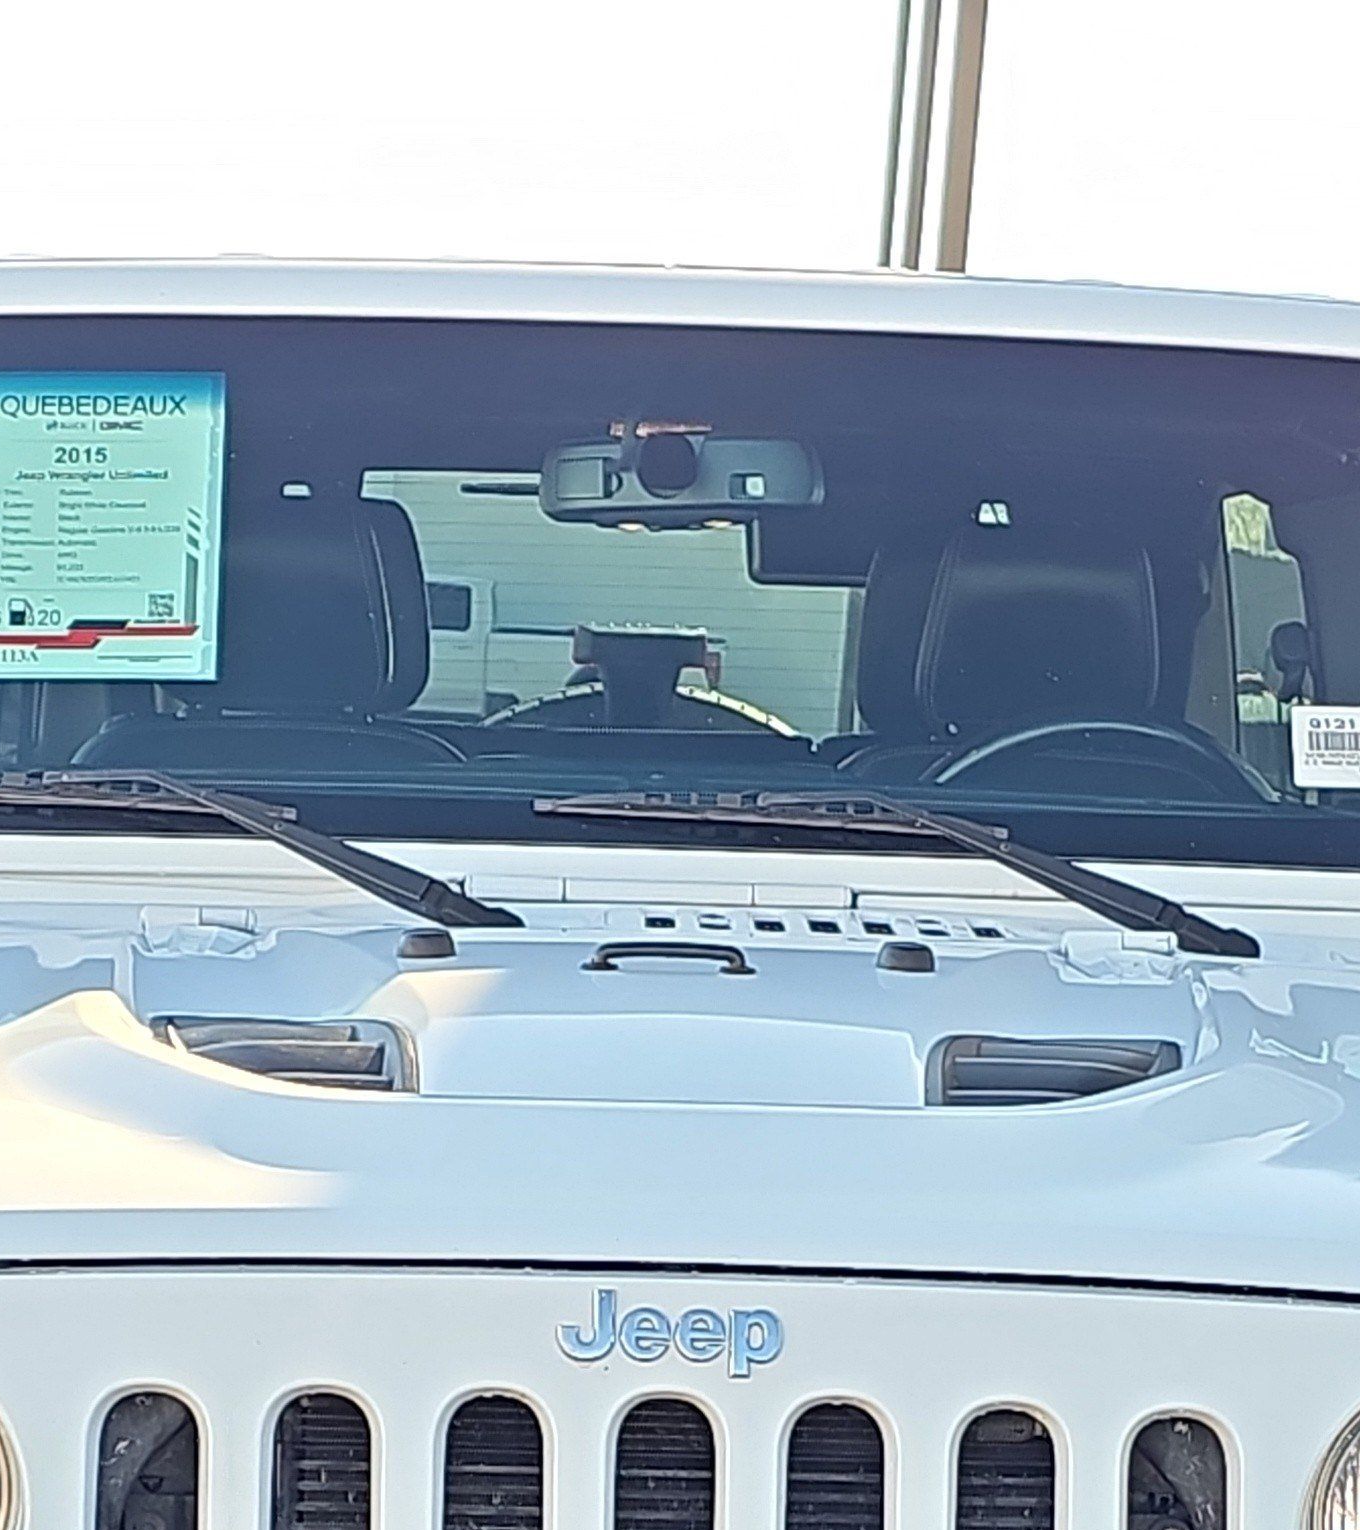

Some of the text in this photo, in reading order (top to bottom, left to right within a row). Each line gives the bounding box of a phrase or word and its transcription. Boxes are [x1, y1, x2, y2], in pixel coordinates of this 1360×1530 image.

[0, 395, 187, 417] QUEBEDEAUX
[54, 447, 108, 463] 2015
[37, 610, 61, 626] 20
[555, 1288, 784, 1379] Jeep
